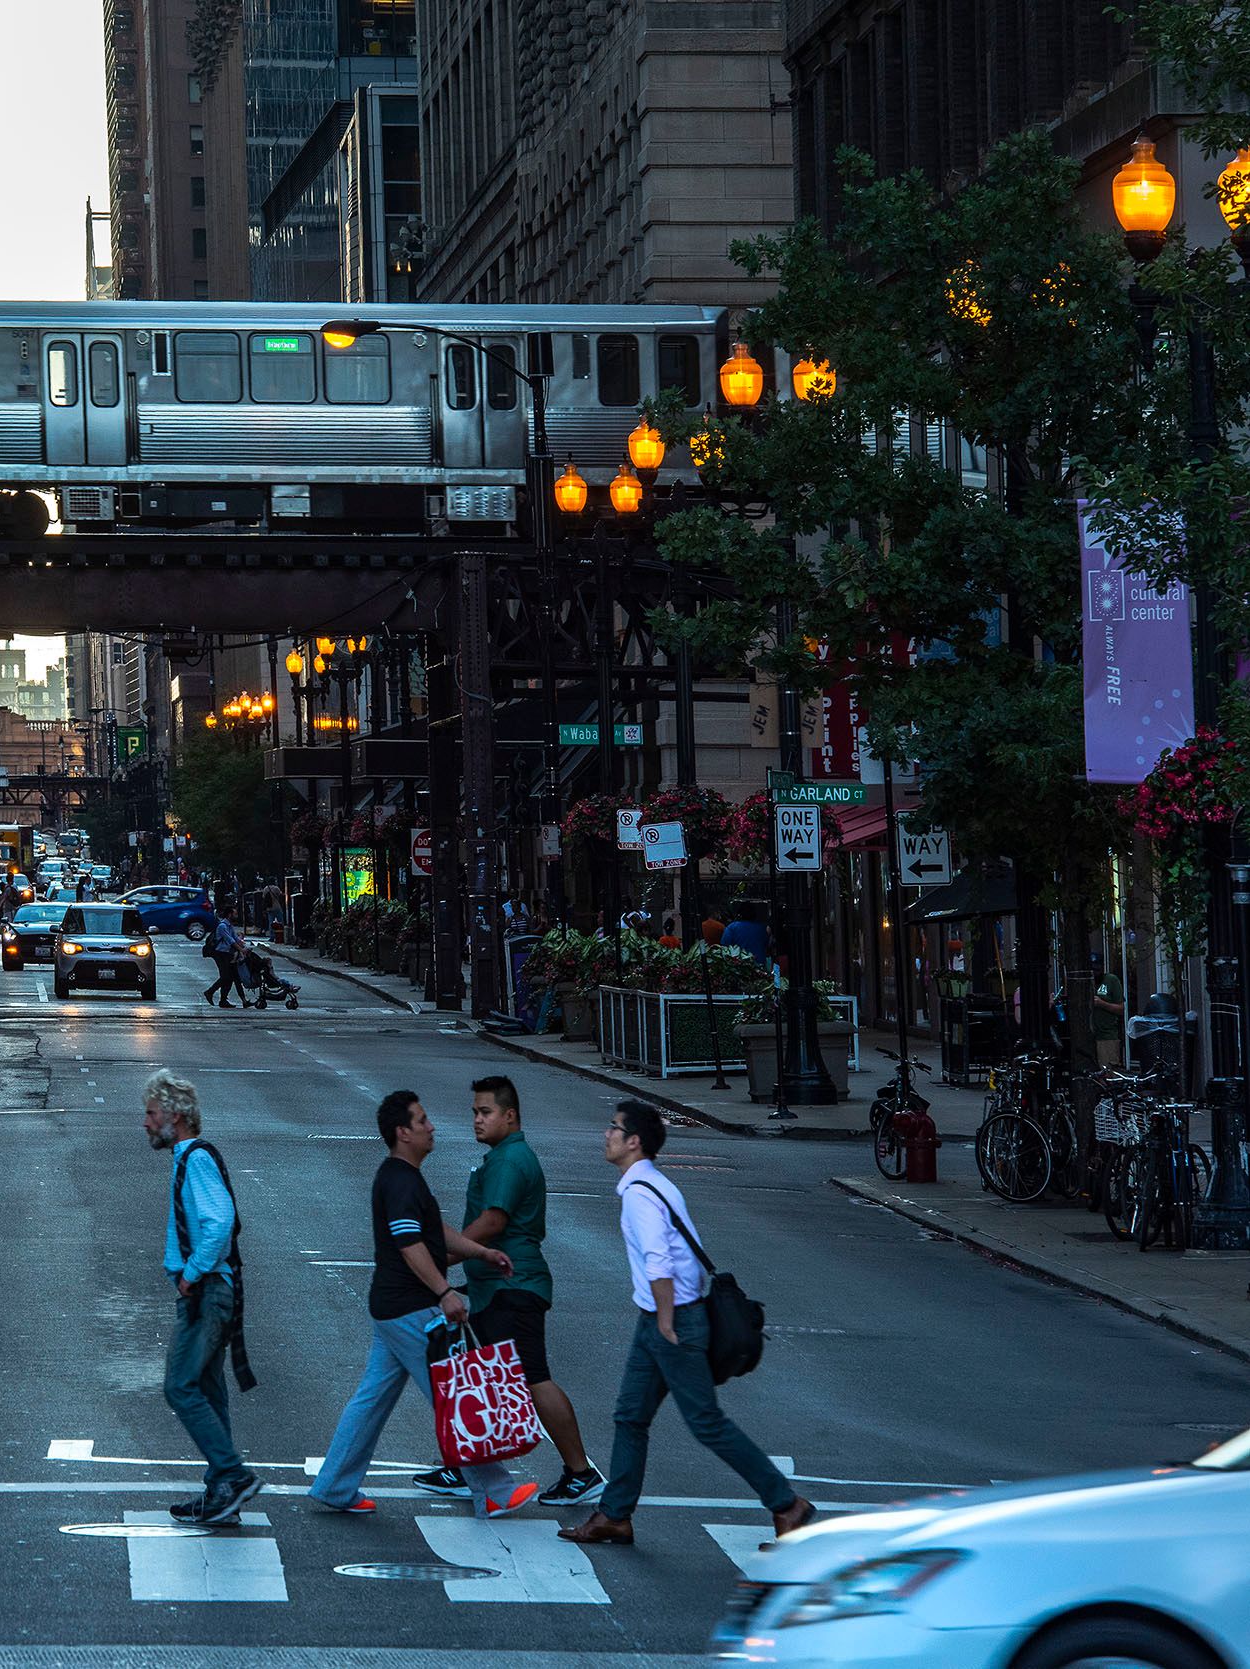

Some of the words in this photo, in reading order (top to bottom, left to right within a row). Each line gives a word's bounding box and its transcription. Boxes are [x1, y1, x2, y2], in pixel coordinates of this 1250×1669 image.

[1131, 607, 1175, 620] center
[1106, 625, 1114, 662] ALWAYS
[1107, 666, 1122, 705] FREE
[752, 705, 770, 735] JEM
[802, 706, 819, 735] JEM
[849, 690, 860, 772] pplies
[570, 727, 598, 740] Waba
[821, 697, 834, 773] Print
[790, 787, 850, 800] GARLAND
[854, 791, 863, 799] CT
[782, 811, 813, 826] ONE
[782, 829, 814, 844] WAY
[904, 837, 943, 855] WAY
